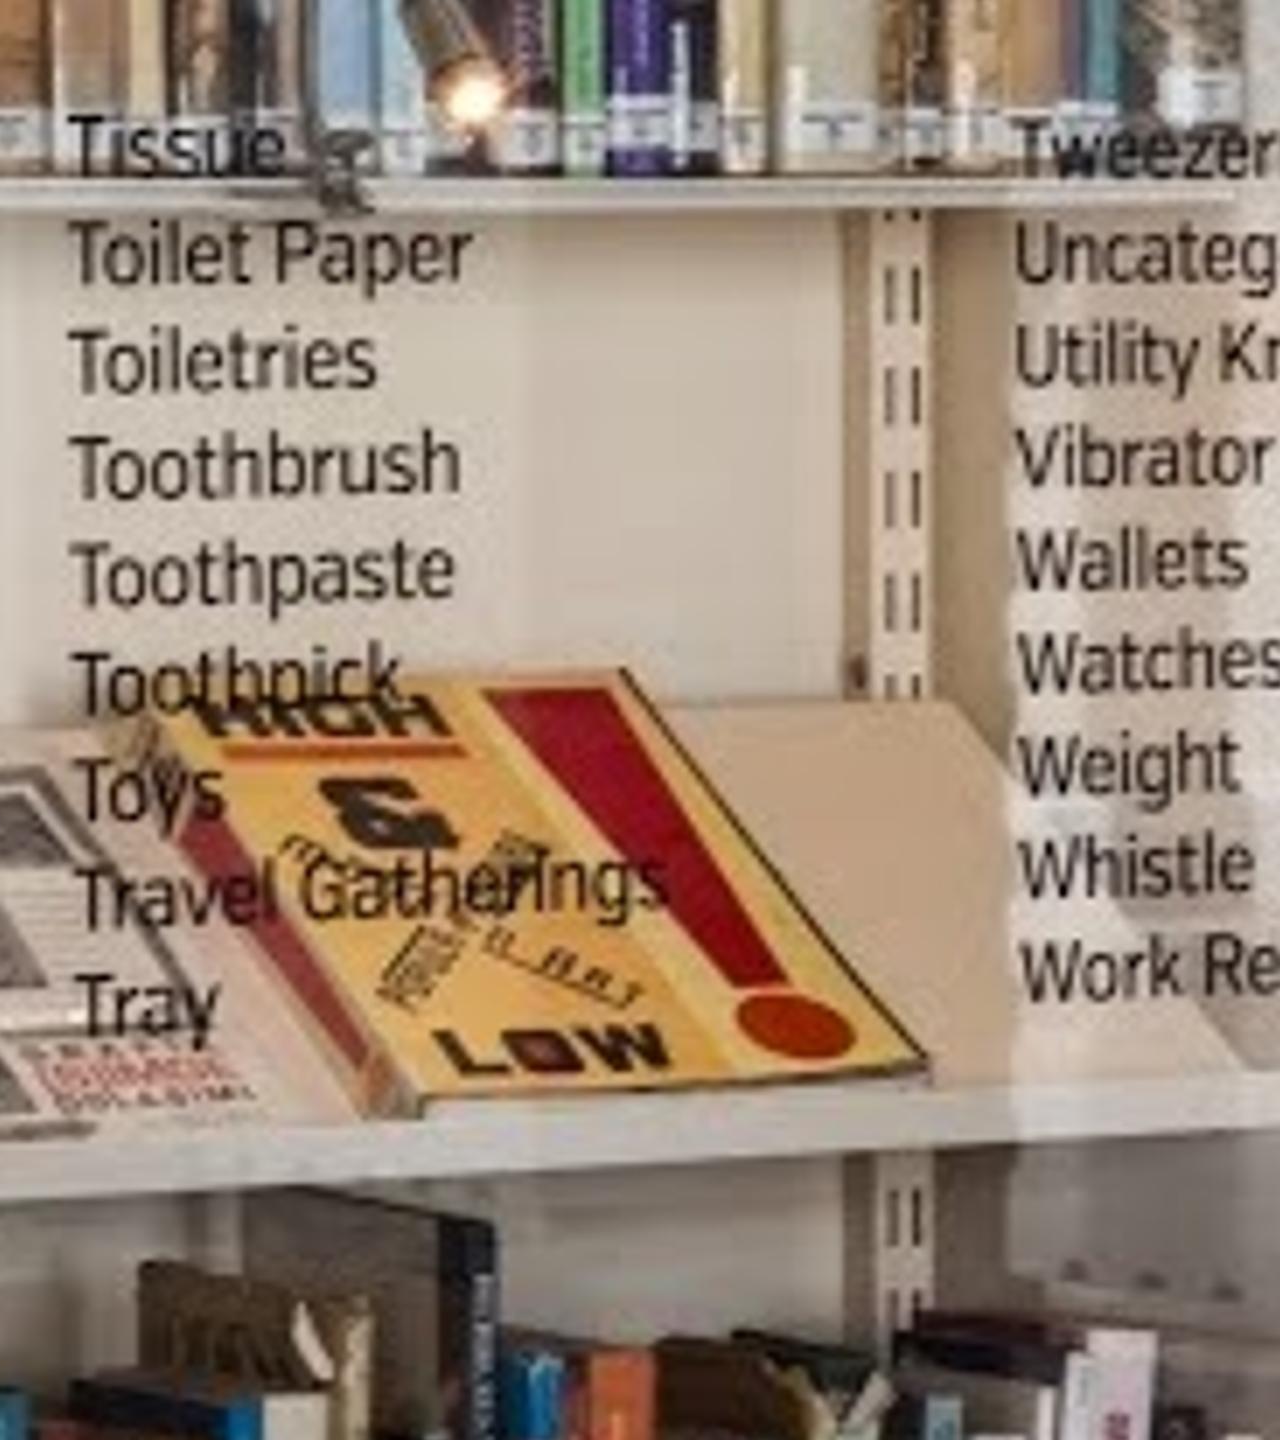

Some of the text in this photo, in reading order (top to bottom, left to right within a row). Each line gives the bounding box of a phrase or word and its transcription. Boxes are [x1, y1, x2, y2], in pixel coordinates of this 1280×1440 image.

[67, 115, 286, 178] Tissue
[67, 219, 474, 301] Toilet Paper
[67, 324, 378, 395] Toiletries
[1015, 323, 1199, 399] Utility
[67, 428, 461, 501] Toothbrush
[1015, 424, 1276, 489] Vibrator
[67, 538, 456, 622] Toothpaste
[1016, 526, 1249, 592] Wallets
[70, 639, 405, 728] Toothpick
[72, 757, 227, 840] Toys
[1017, 732, 1242, 813] Weight
[74, 844, 672, 928] Travel Gatherings
[1017, 832, 1257, 900] Whistle
[1019, 938, 1183, 1005] Work
[74, 973, 221, 1052] Tray
[431, 1022, 672, 1080] LOW
